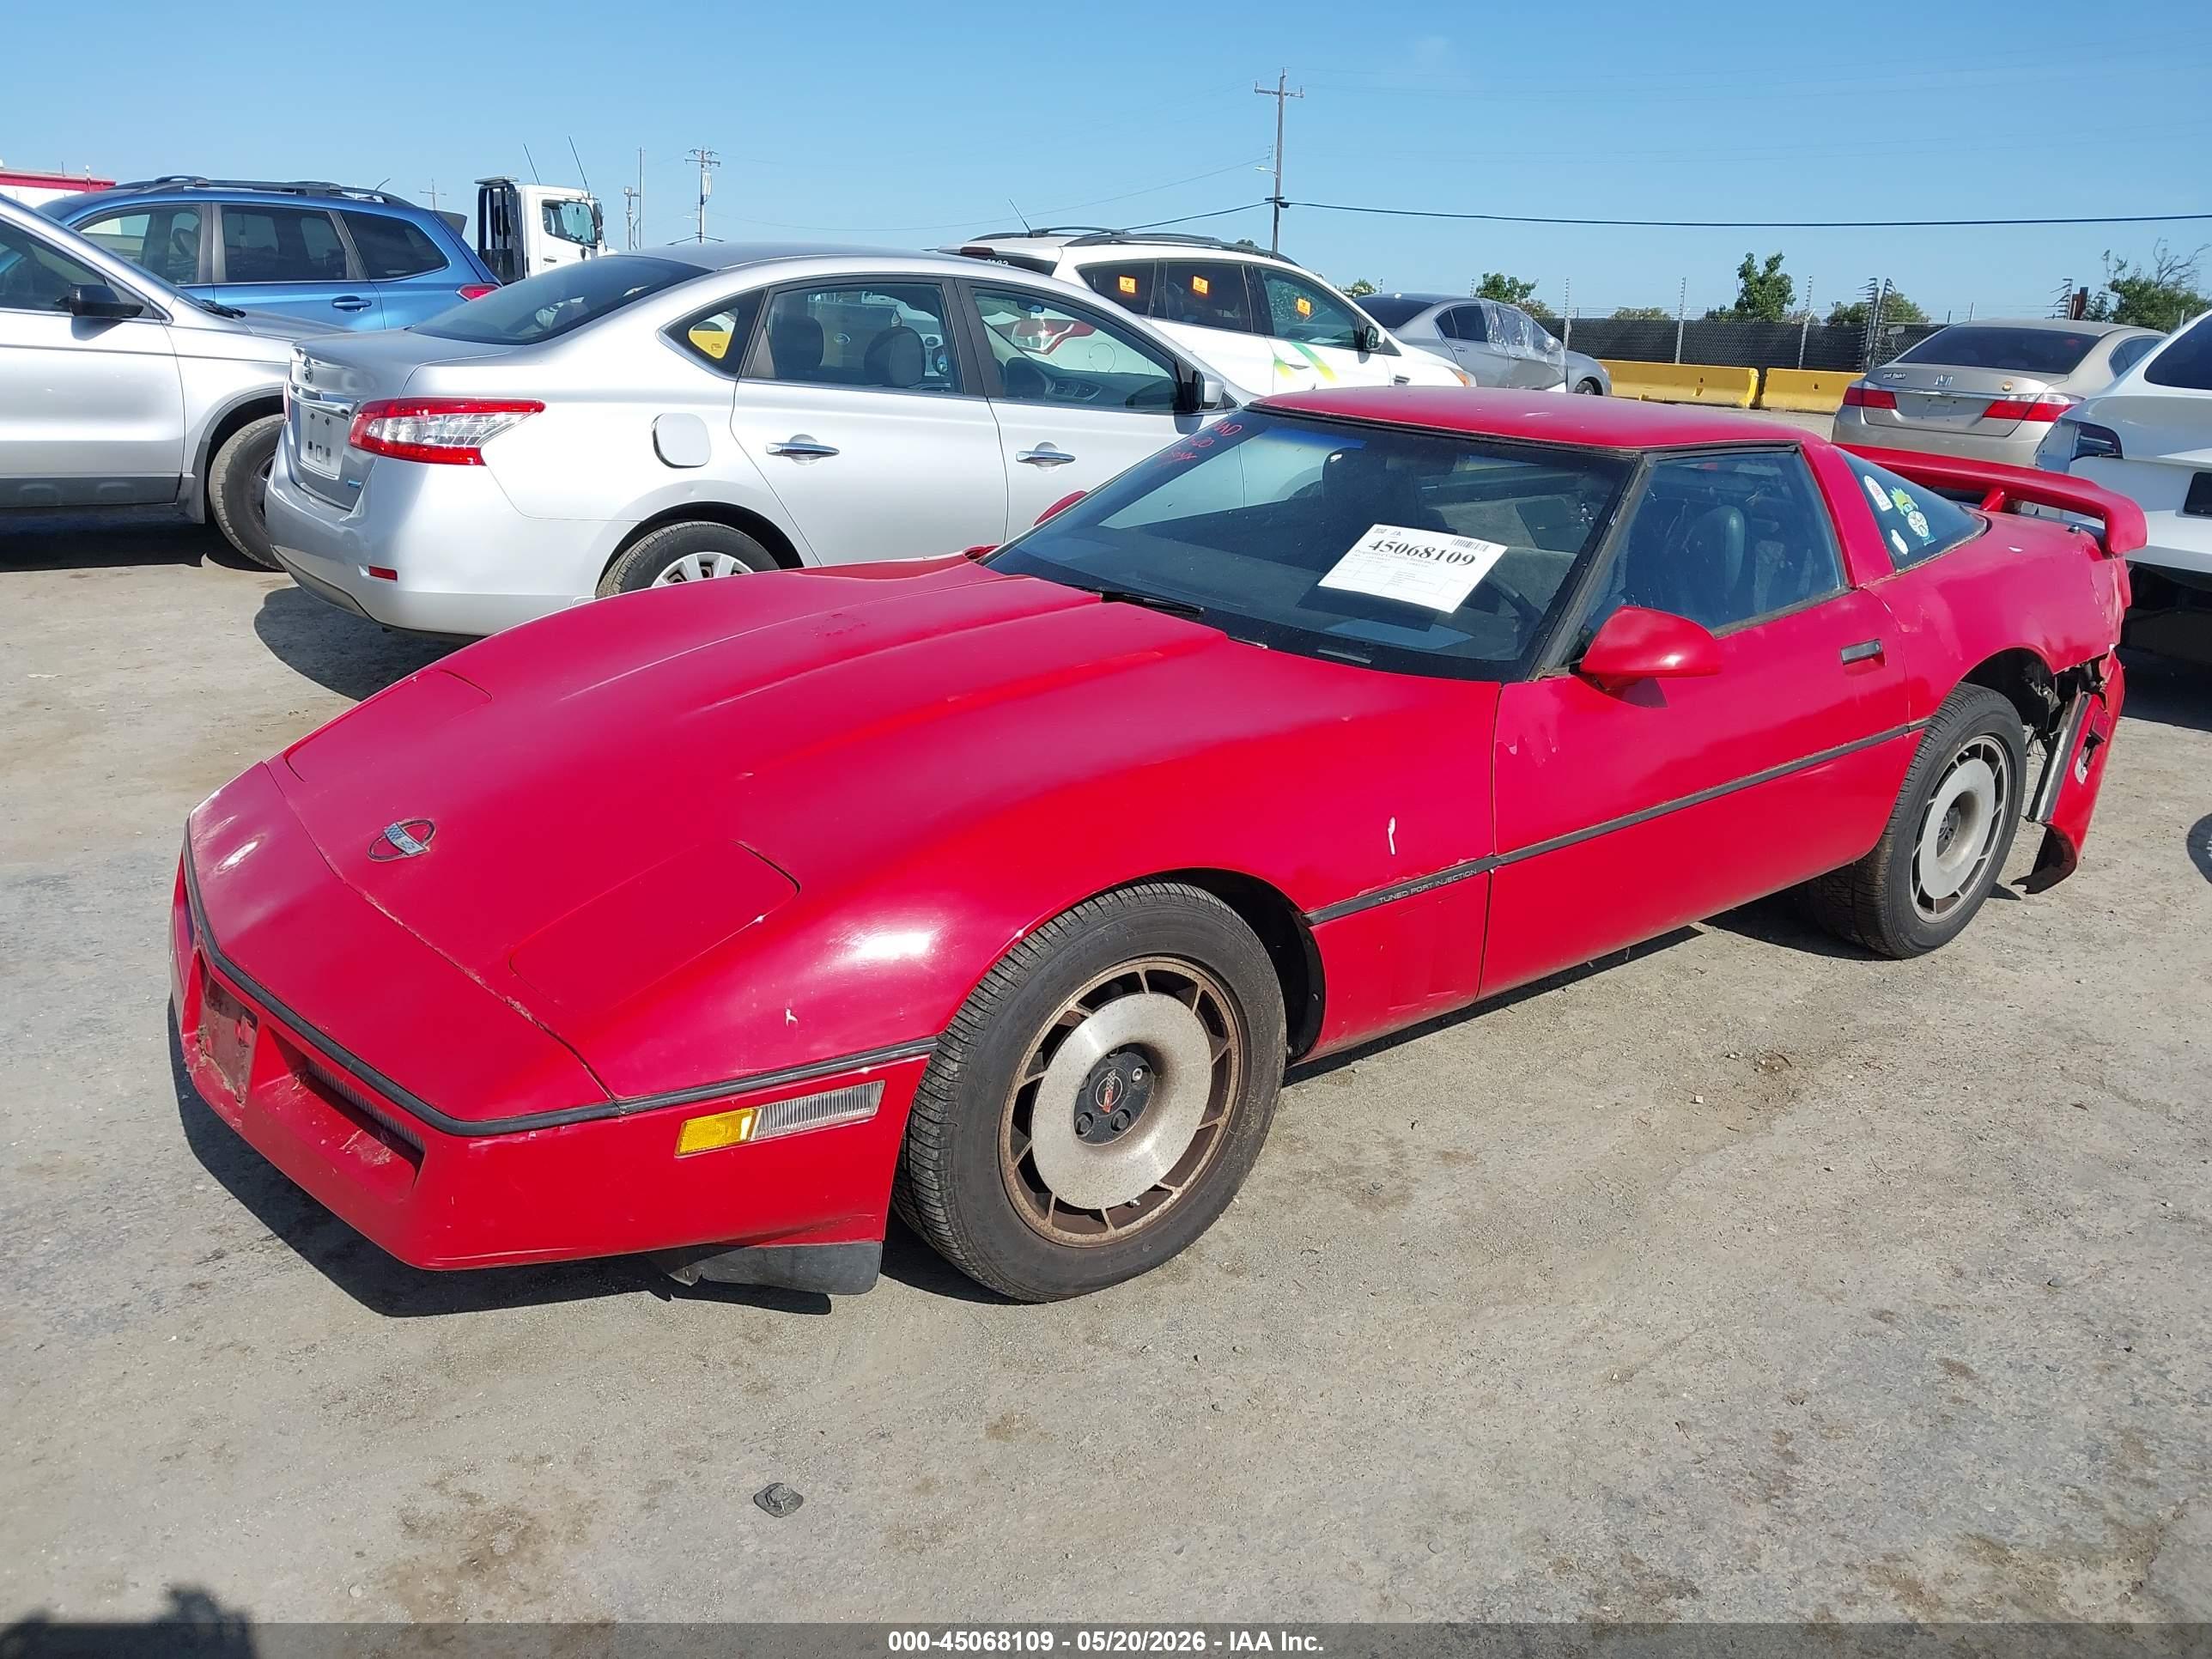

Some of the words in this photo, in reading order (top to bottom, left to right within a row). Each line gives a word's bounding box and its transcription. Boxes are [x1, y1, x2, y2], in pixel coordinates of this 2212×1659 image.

[1368, 539, 1476, 567] 45068109
[1378, 890, 1409, 903] TUNED
[1410, 882, 1434, 895] PORT
[1436, 869, 1477, 886] INJECTION
